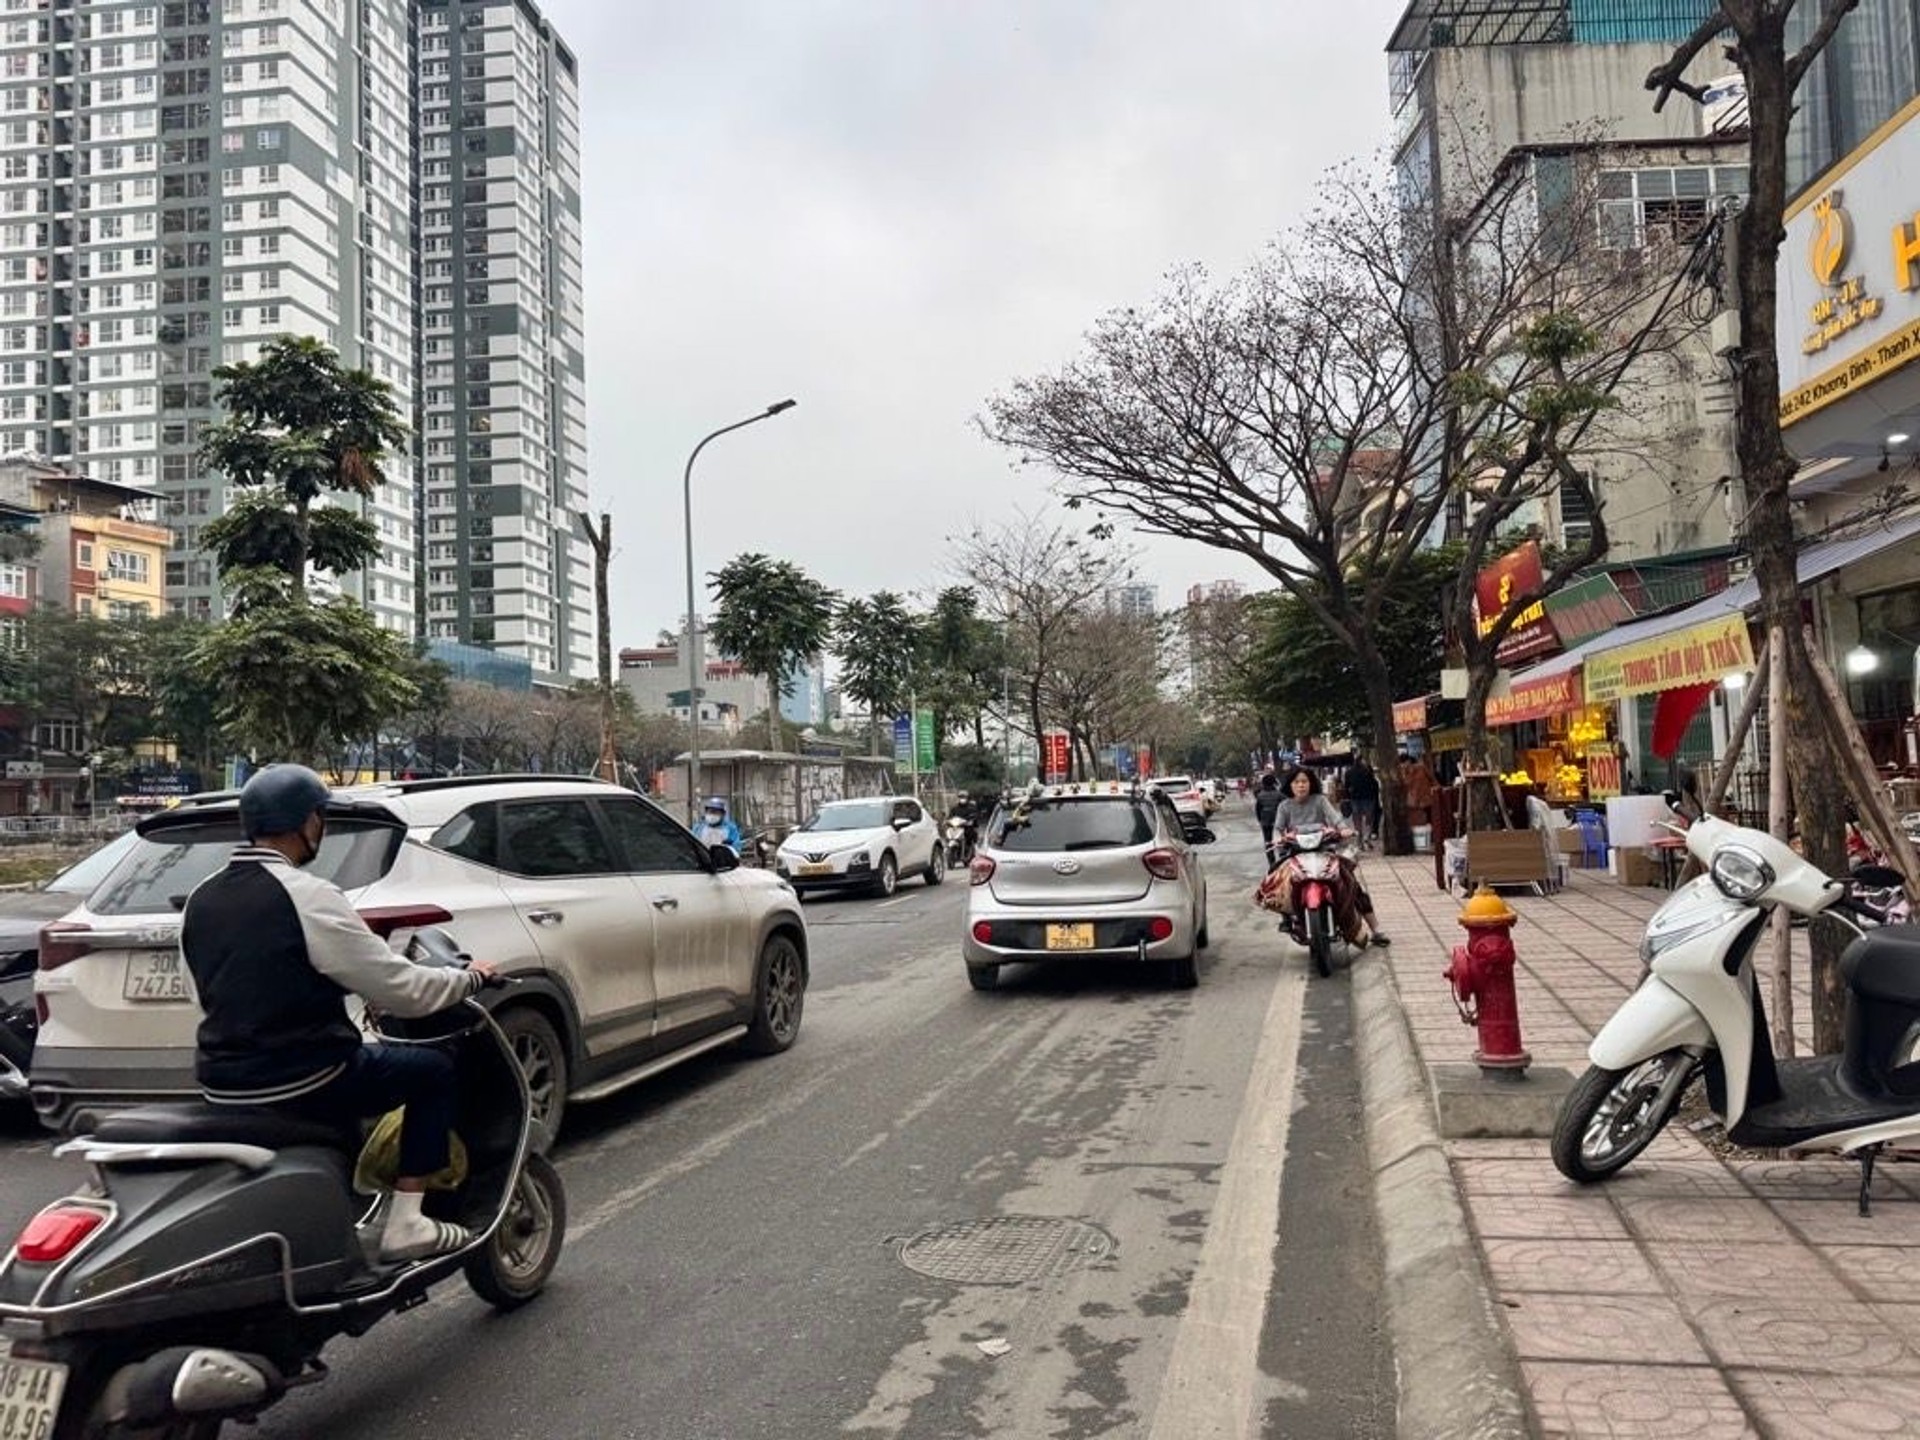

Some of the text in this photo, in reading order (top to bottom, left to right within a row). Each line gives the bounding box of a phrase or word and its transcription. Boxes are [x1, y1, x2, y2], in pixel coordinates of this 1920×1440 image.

[1877, 335, 1910, 364] Thanh
[1623, 656, 1659, 687] TRUNG
[0, 1402, 52, 1440] 8.96
